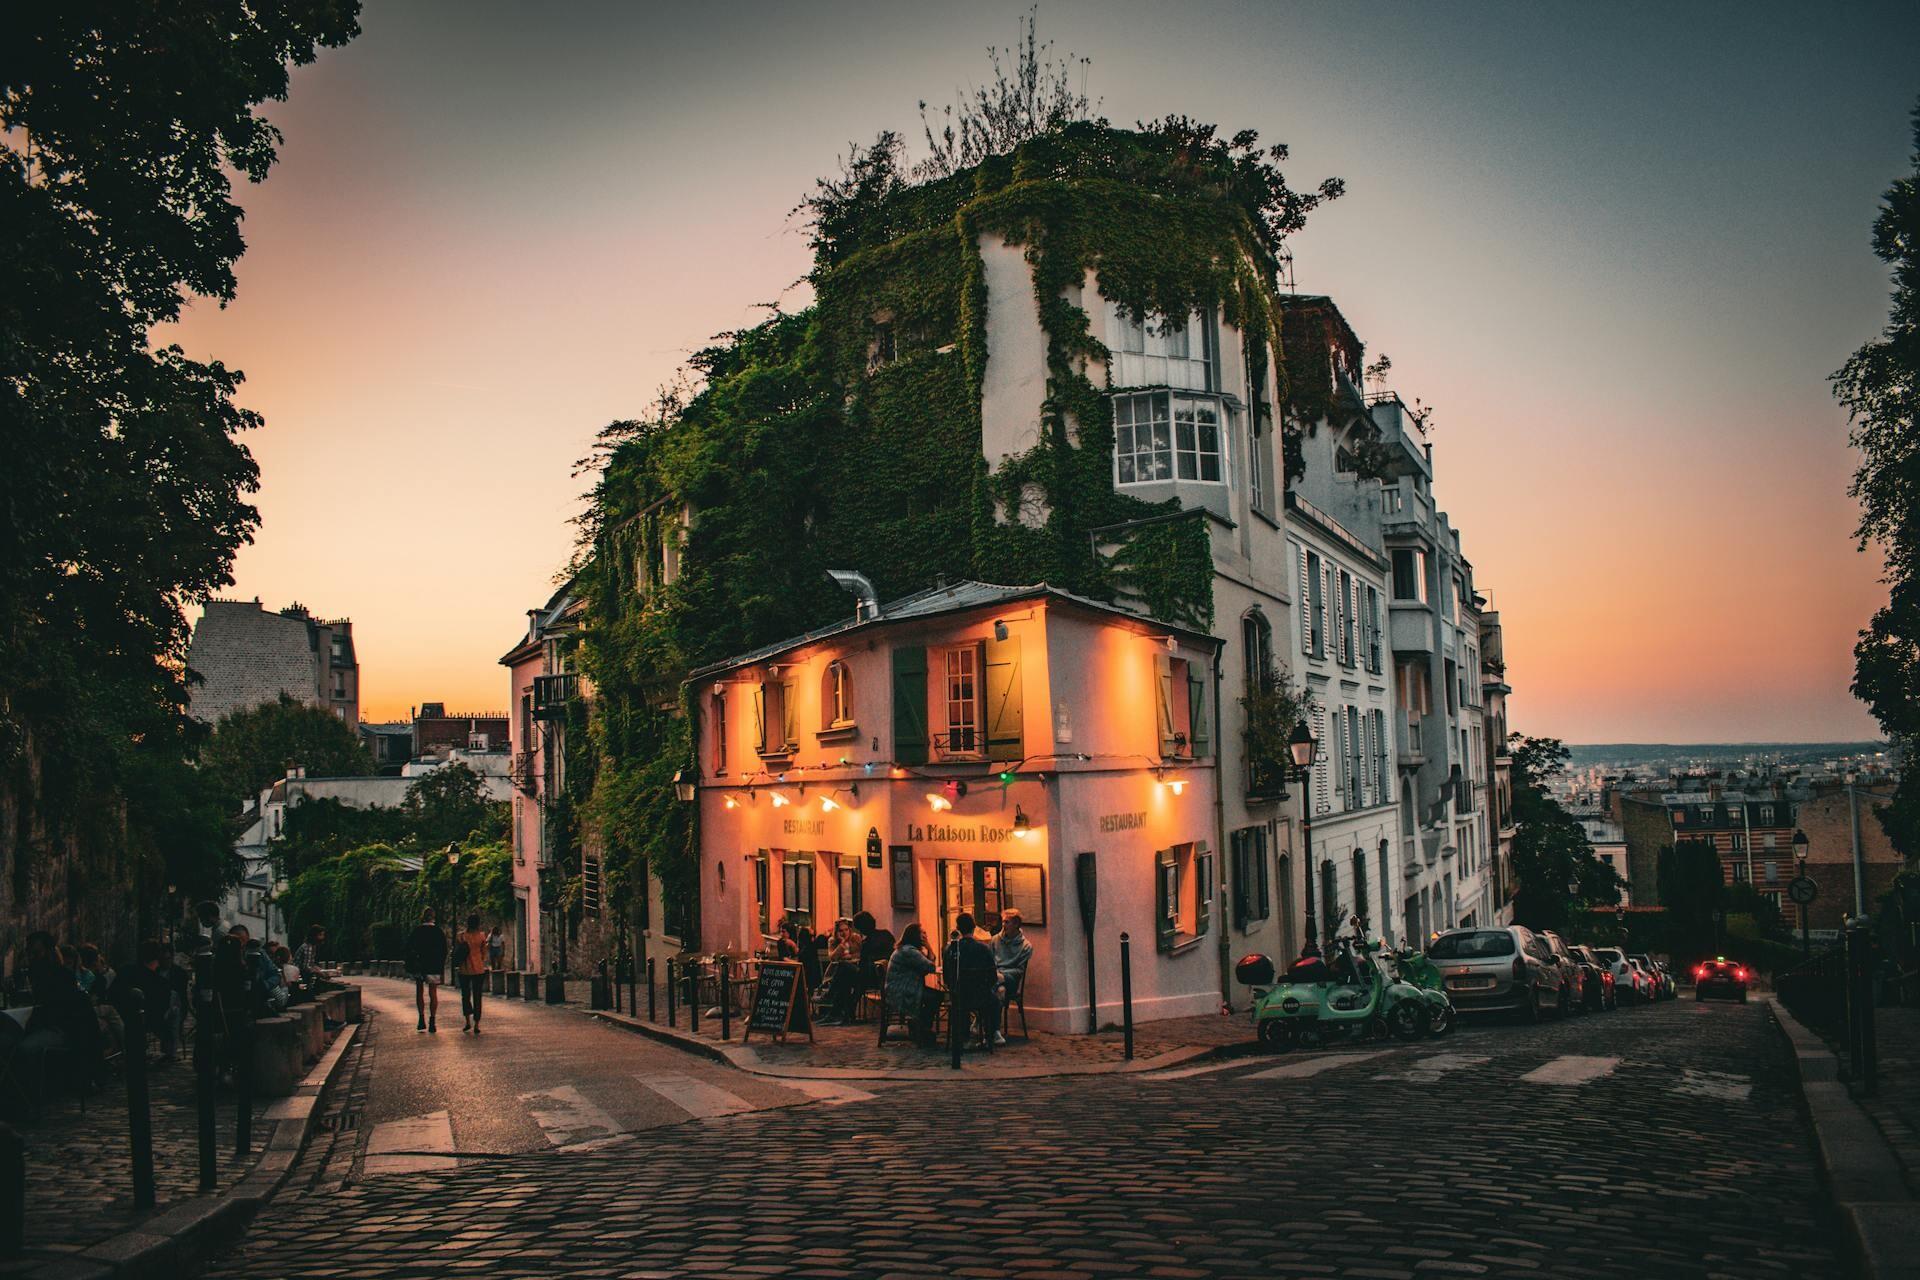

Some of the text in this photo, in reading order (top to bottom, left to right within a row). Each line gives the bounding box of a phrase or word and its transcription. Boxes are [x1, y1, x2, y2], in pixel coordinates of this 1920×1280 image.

[1099, 811, 1147, 832] RESTAURANT
[908, 824, 923, 841] La
[927, 824, 976, 841] Maison
